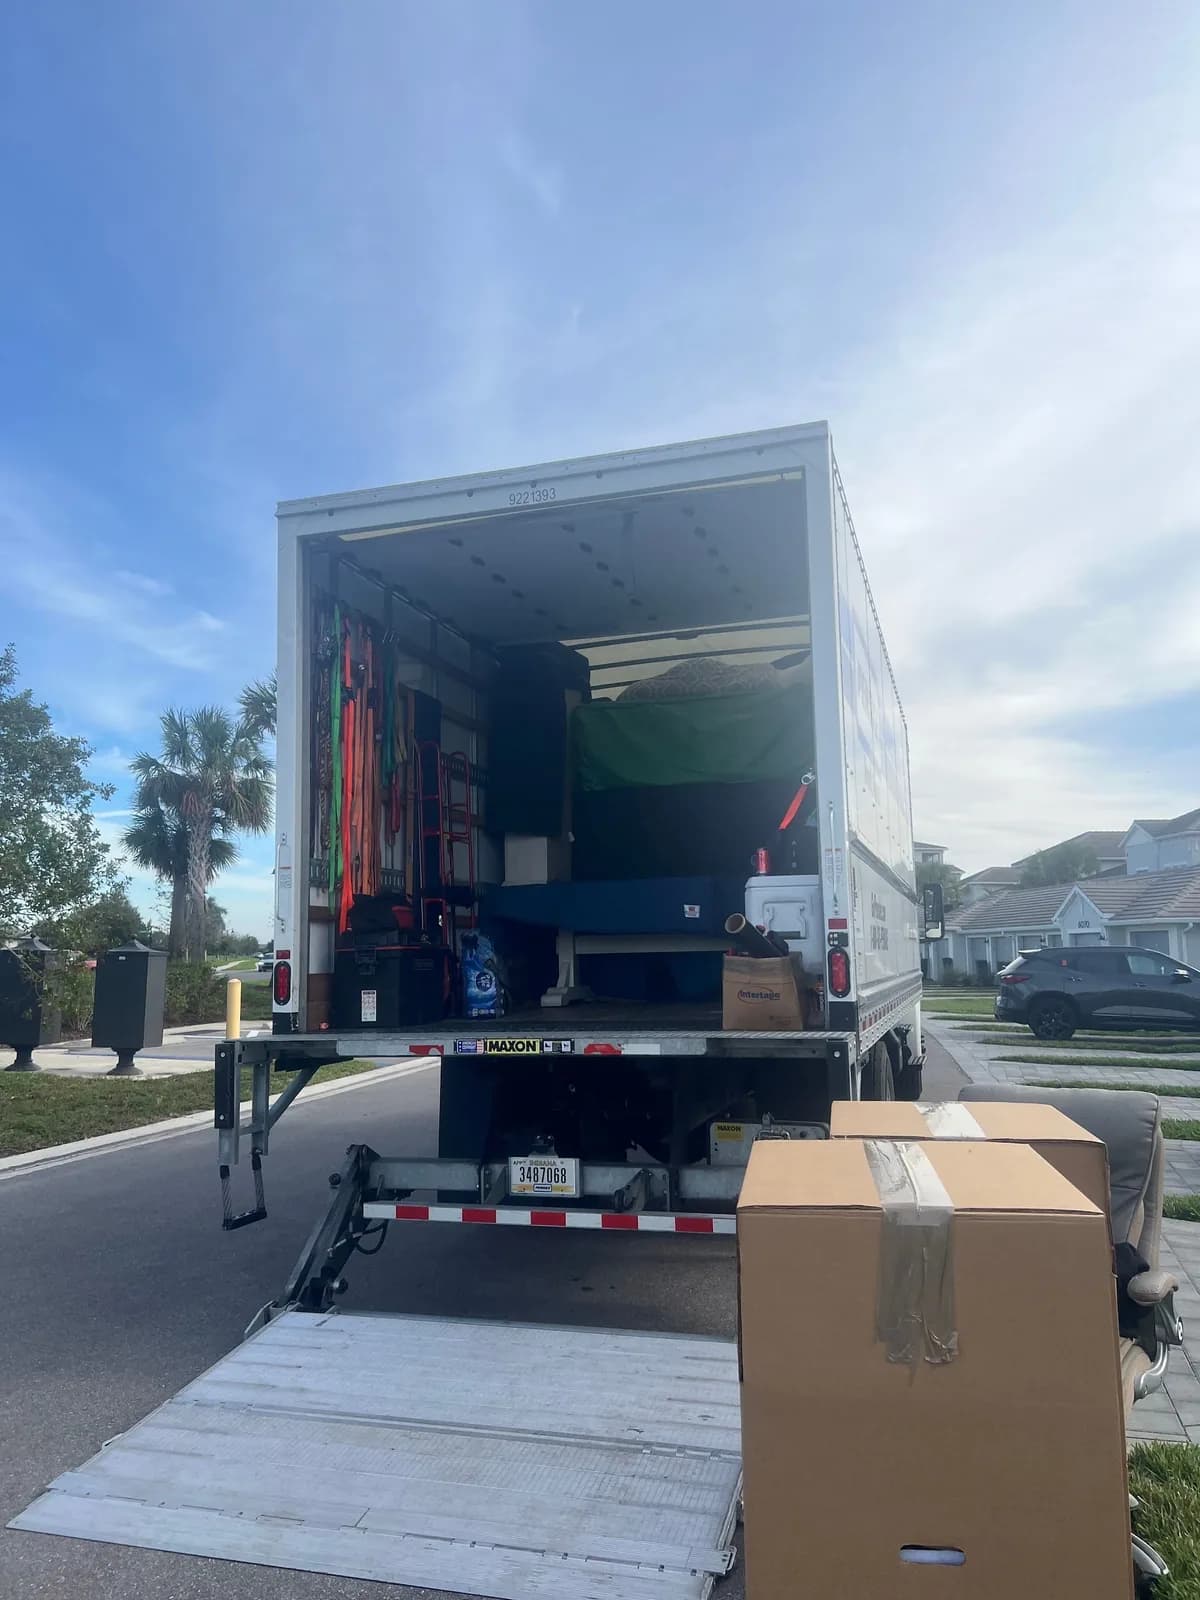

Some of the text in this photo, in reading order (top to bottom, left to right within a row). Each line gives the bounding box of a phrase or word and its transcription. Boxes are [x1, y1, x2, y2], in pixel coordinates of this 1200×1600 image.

[509, 487, 556, 505] 9221393
[488, 1040, 537, 1052] MAXON
[519, 1166, 567, 1184] 3487068
